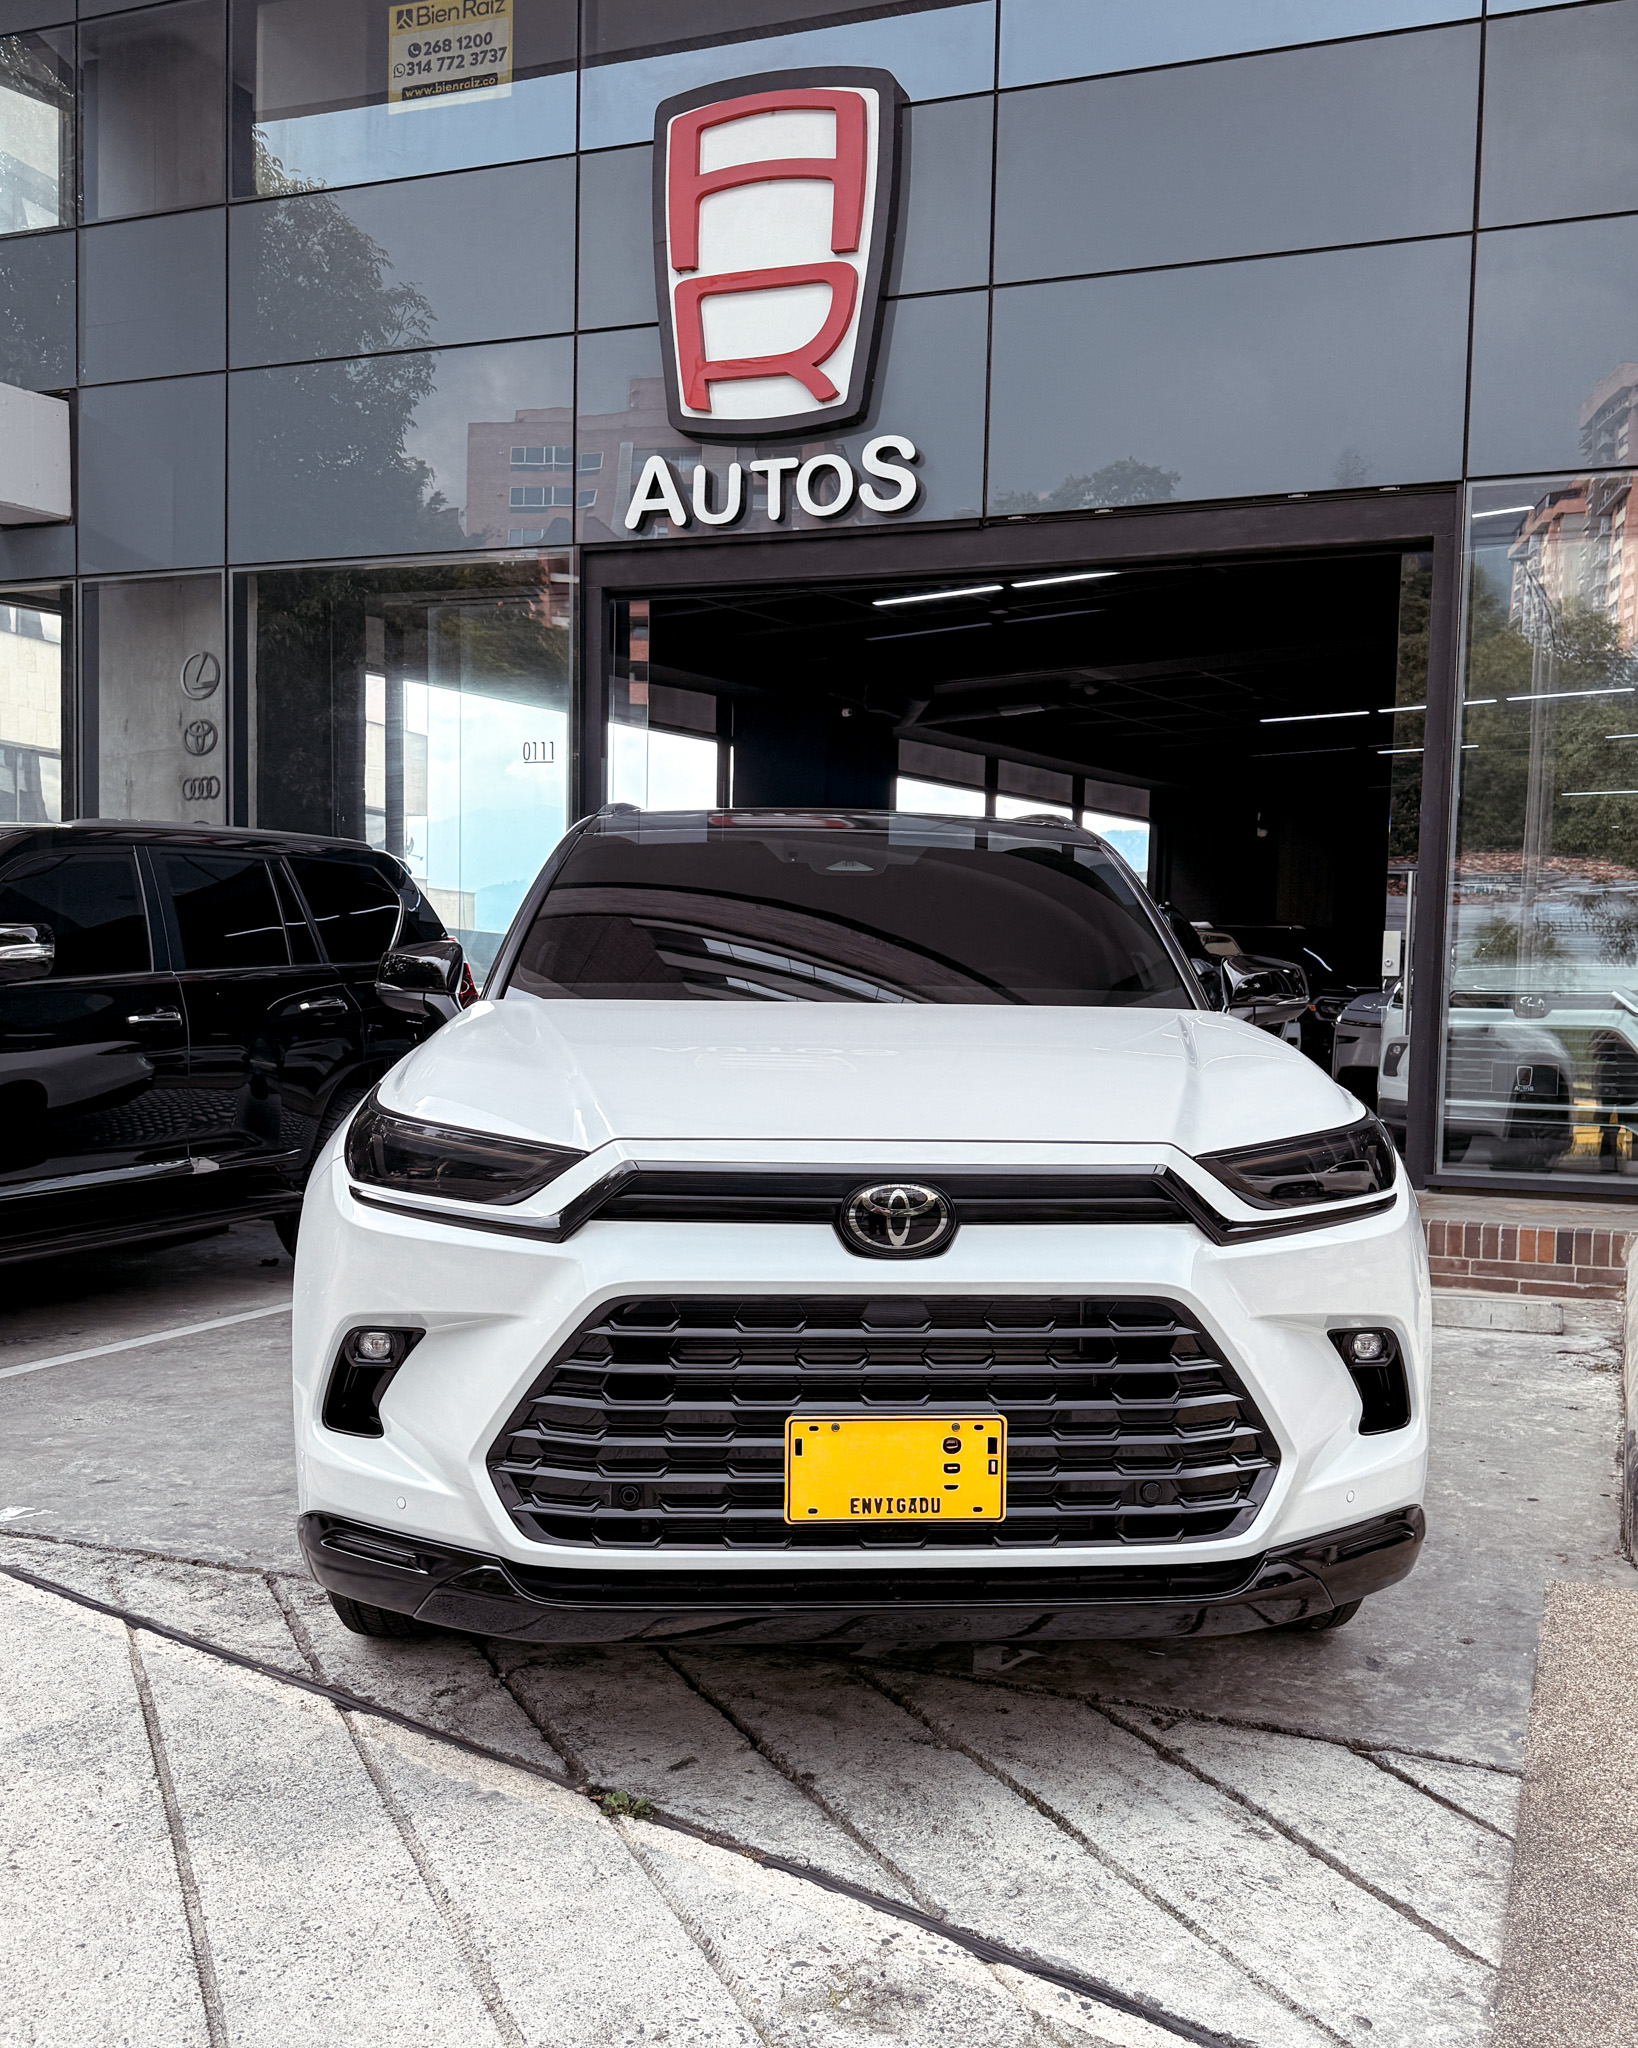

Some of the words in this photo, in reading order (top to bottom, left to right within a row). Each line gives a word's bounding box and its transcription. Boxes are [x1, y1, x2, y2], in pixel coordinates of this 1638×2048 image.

[417, 4, 460, 26] Bien
[424, 38, 452, 56] 268
[457, 32, 493, 50] 1200
[406, 61, 433, 77] 314
[437, 54, 465, 72] 772
[470, 46, 508, 66] 3737
[405, 77, 496, 98] www.bienraiz.co
[624, 434, 918, 531] AUTOS
[522, 741, 555, 761] 0111
